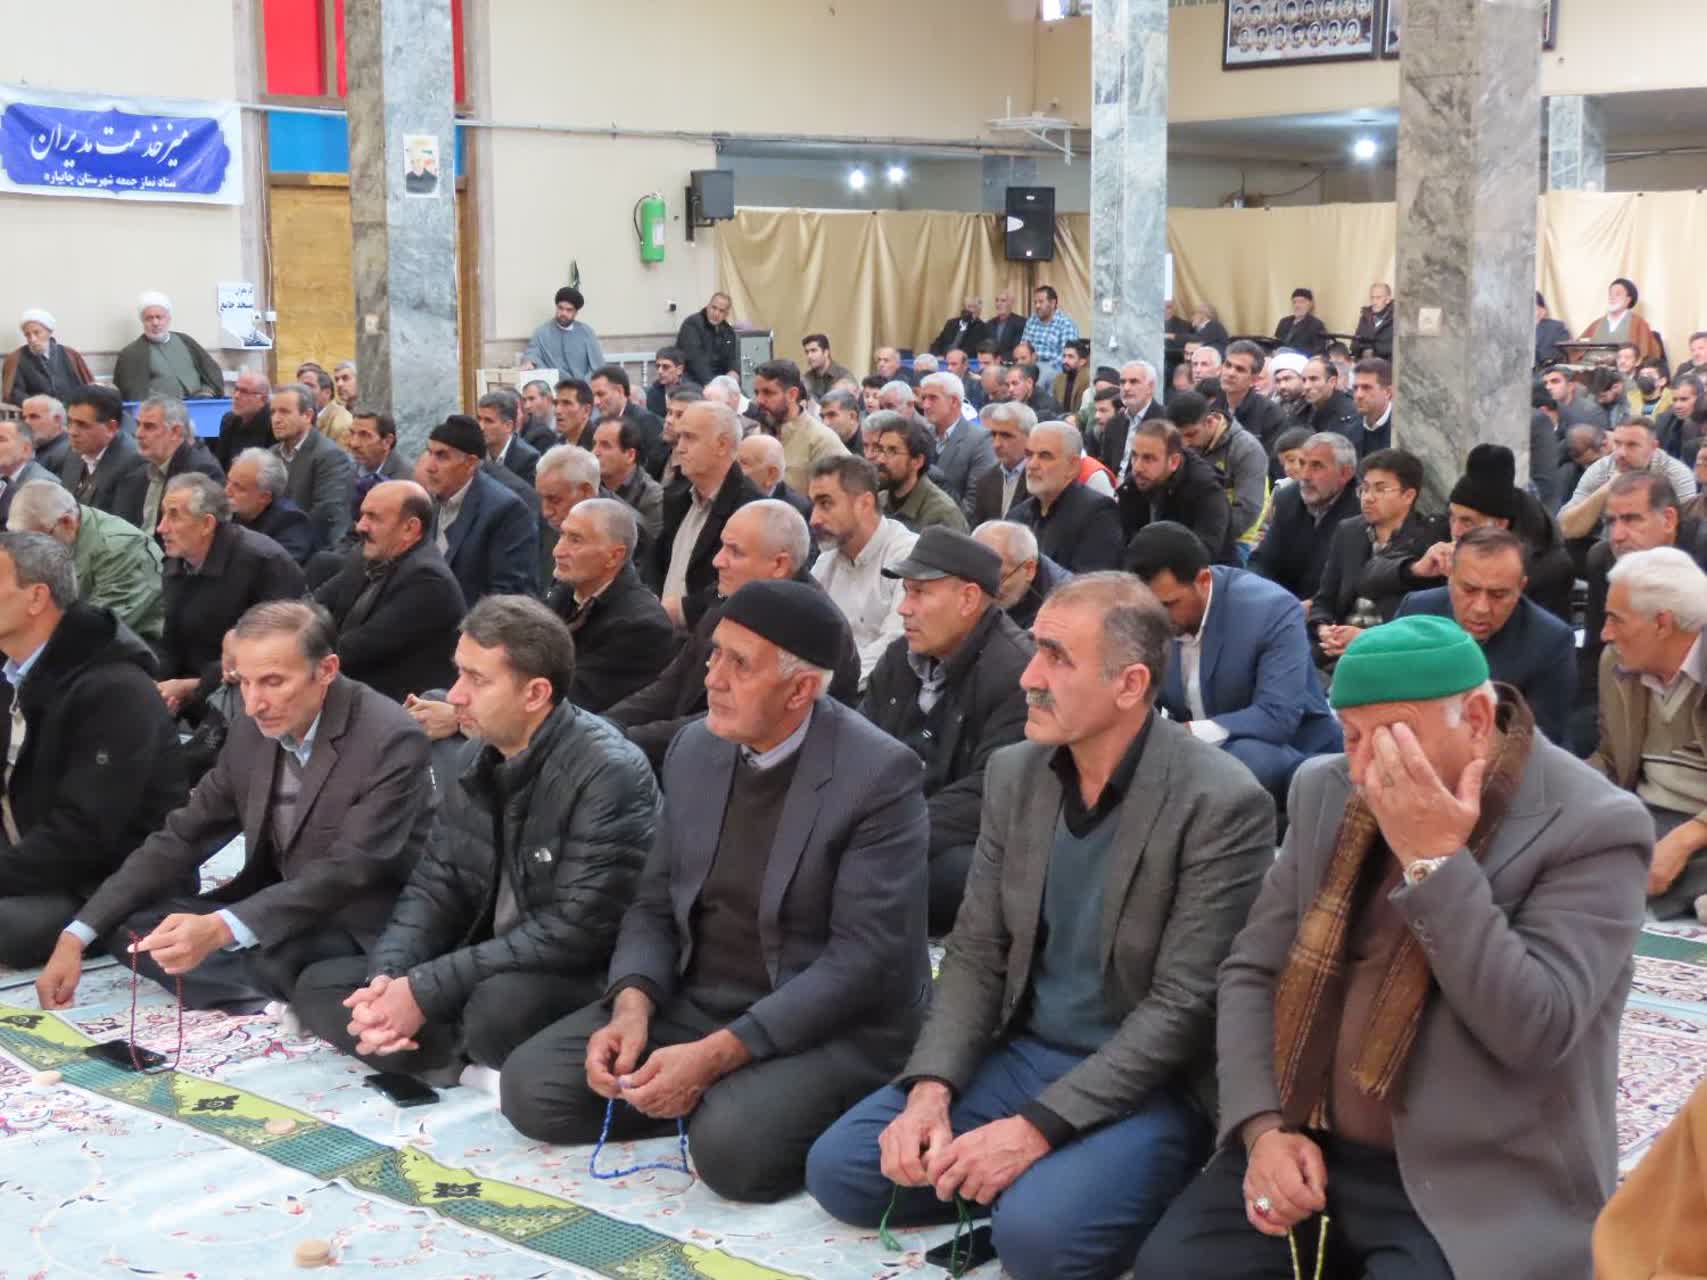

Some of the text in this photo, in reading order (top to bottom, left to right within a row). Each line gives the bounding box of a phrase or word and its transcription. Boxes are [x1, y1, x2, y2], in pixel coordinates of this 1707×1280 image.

[30, 122, 93, 168] مدیران
[76, 172, 114, 187] شهرستان
[115, 176, 137, 188] جمعه
[139, 176, 156, 189] نماز
[157, 175, 177, 188] ستاد
